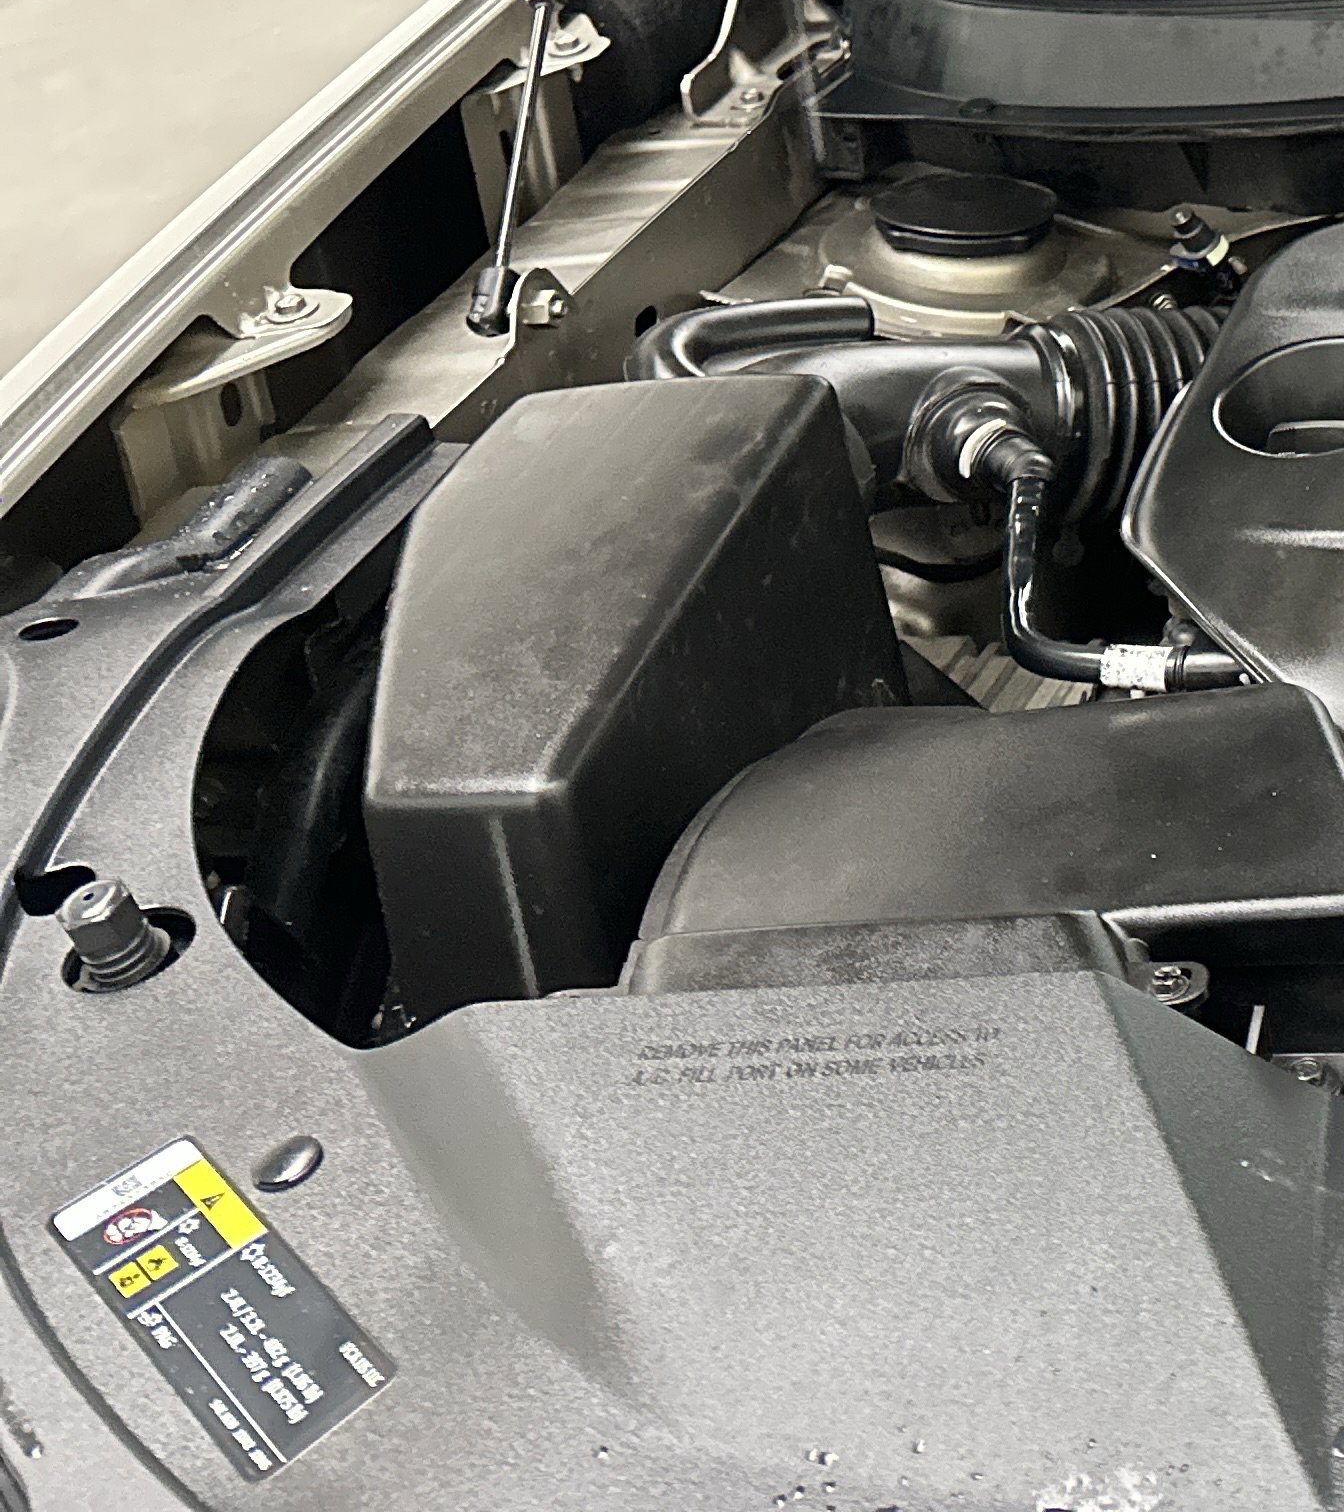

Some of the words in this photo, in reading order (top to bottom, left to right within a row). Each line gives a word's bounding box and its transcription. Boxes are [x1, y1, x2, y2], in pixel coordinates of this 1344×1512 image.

[638, 1042, 722, 1061] REMOVE
[727, 1039, 772, 1057] THIS
[776, 1036, 839, 1054] PANEL
[844, 1033, 885, 1050] FOR
[888, 1028, 967, 1048] ACCESS
[820, 1058, 884, 1077] SOME
[888, 1053, 988, 1074] VEHICLES
